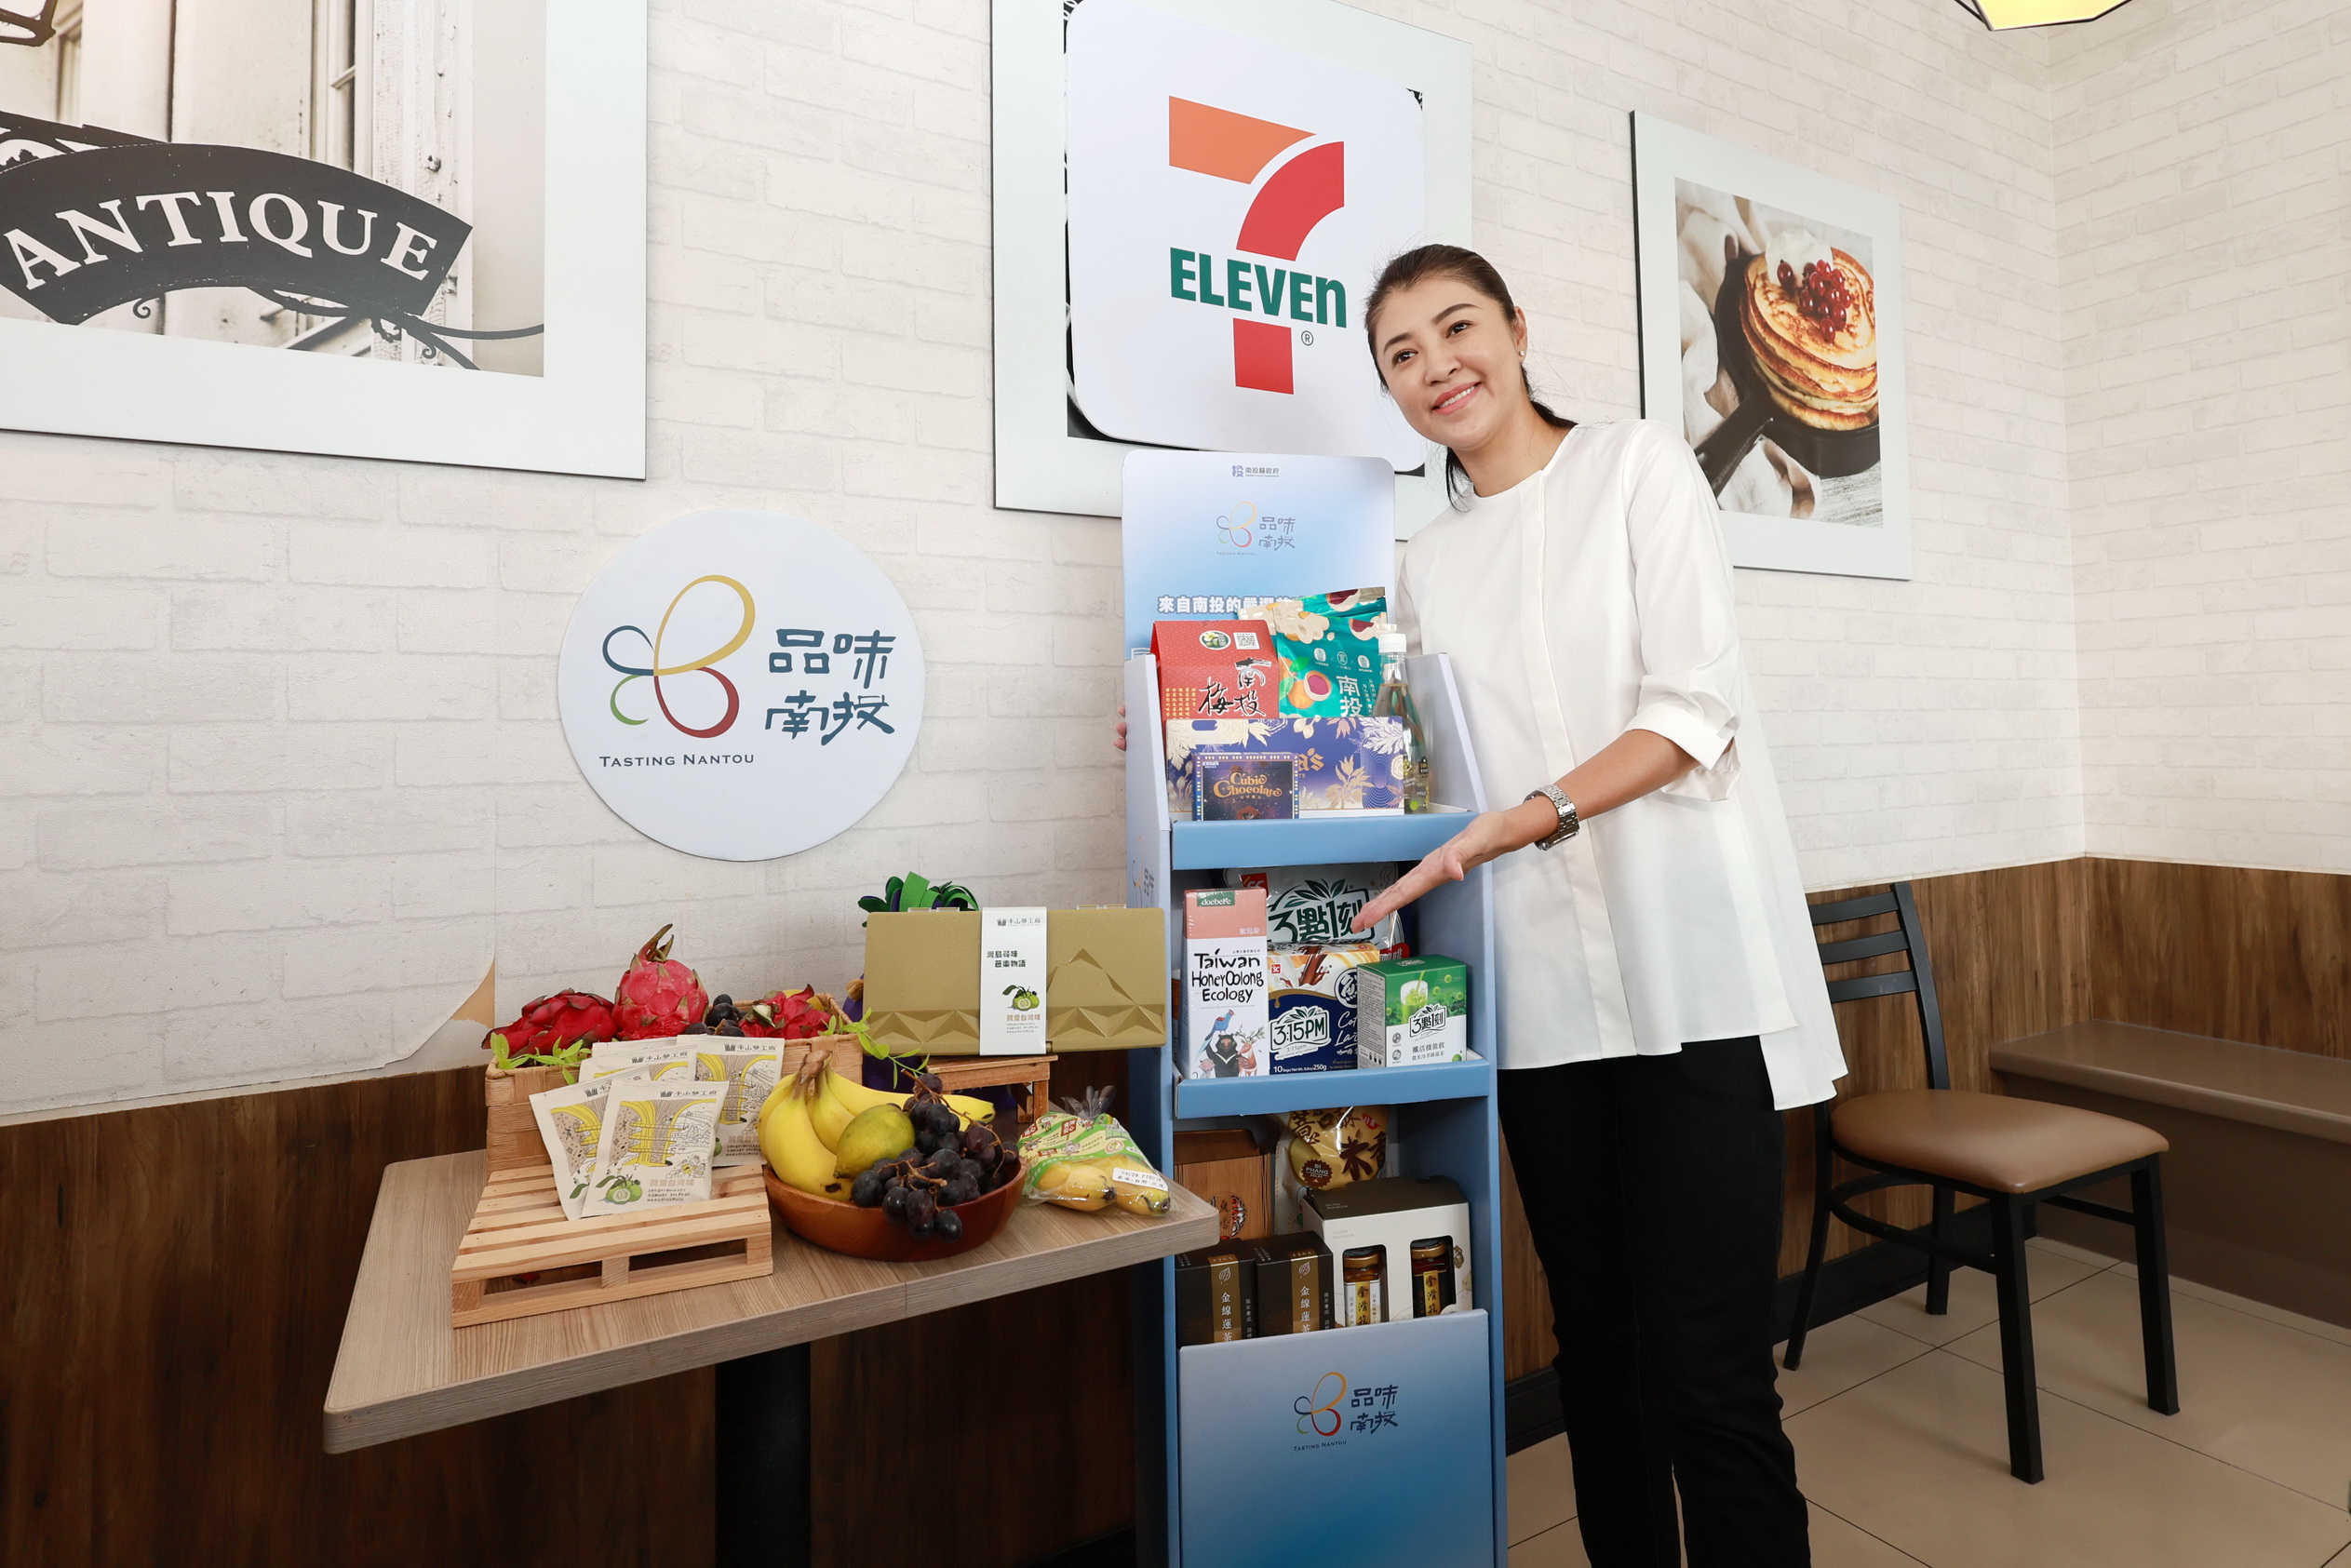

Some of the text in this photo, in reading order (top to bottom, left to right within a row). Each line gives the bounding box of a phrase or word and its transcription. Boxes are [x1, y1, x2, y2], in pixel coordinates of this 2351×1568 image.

[3, 191, 437, 290] ANTIQUE
[1259, 516, 1296, 535] 品味
[1258, 534, 1296, 551] 南投
[769, 629, 896, 689] 品味
[765, 690, 895, 746] 南投
[599, 754, 755, 768] TASTING NANTOU
[1214, 780, 1283, 797] Chocolate
[1194, 948, 1261, 969] Taiwan
[1202, 987, 1254, 1003] Ecology
[1411, 1012, 1444, 1034] 3點1刻
[1221, 1293, 1232, 1342] 金線蓮茶
[1350, 1384, 1398, 1409] 品味
[1350, 1411, 1398, 1434] 南投
